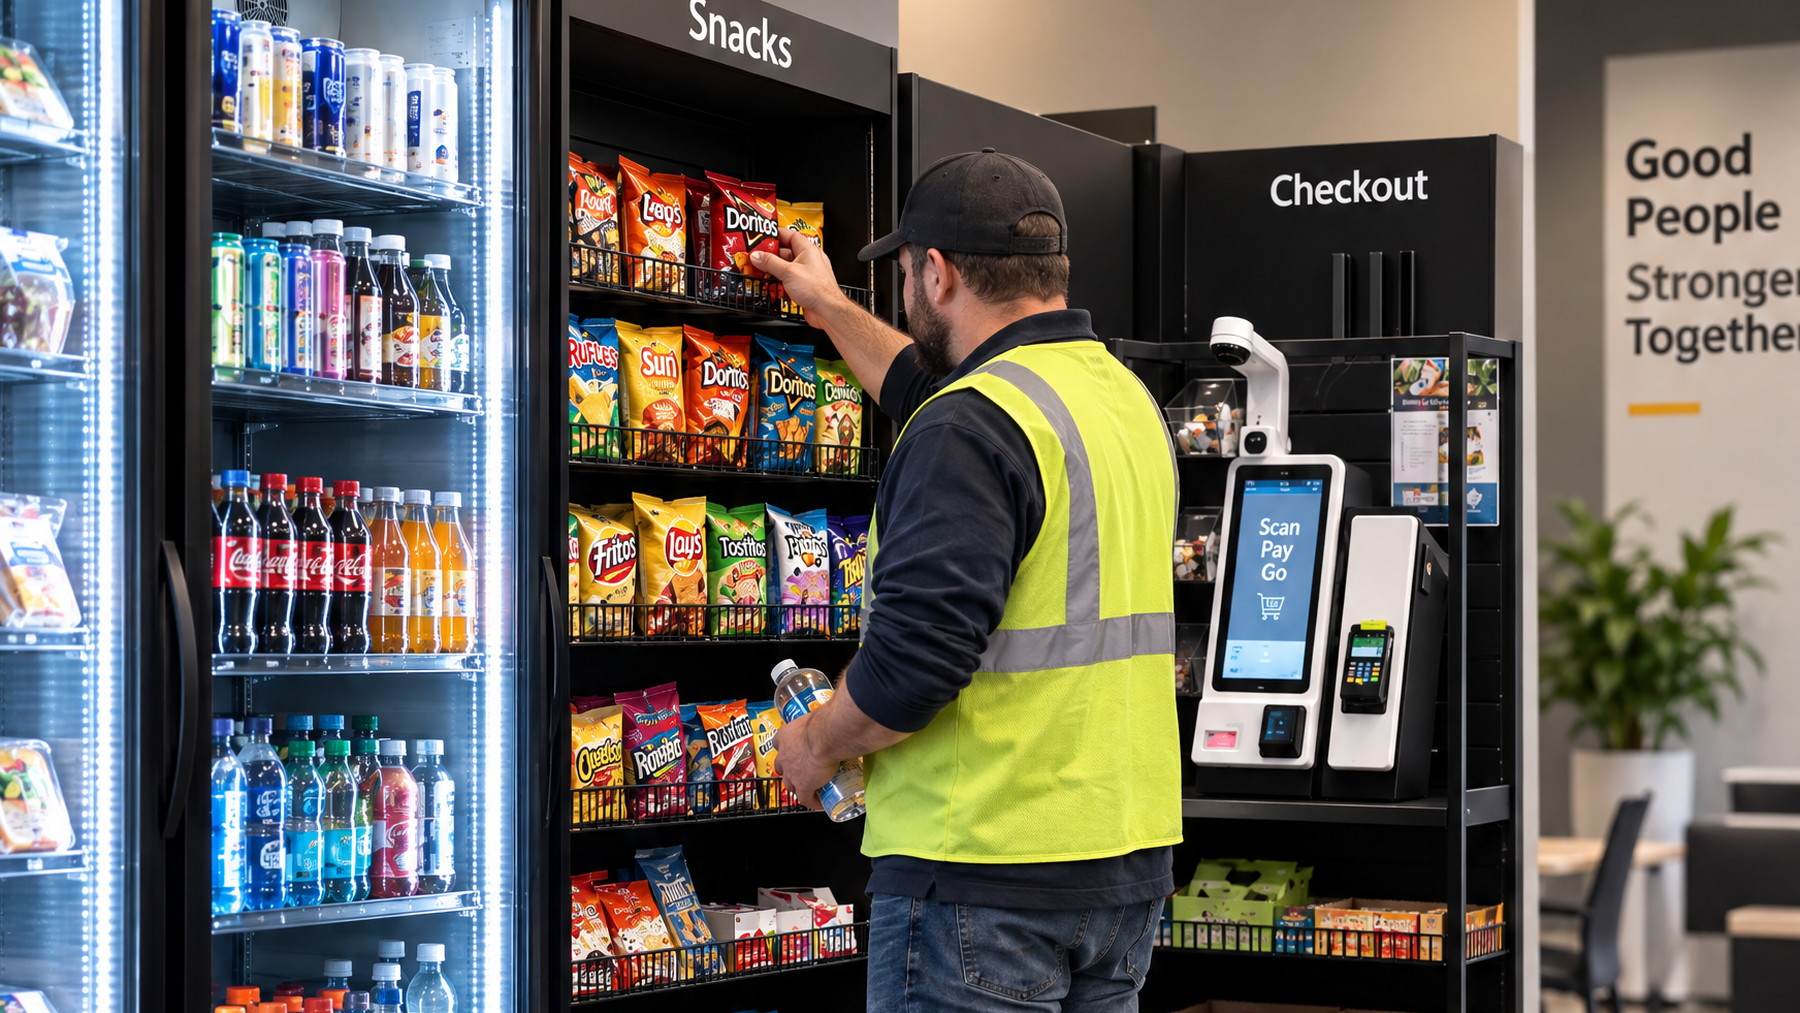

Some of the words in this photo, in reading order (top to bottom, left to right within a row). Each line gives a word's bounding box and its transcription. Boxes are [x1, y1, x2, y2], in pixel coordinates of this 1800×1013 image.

[689, 0, 793, 69] Snacks
[1625, 132, 1752, 181] Good
[1270, 169, 1429, 207] Checkout
[726, 206, 778, 238] Doritos
[1627, 190, 1782, 244] People
[1625, 313, 1800, 365] Togethe
[642, 350, 677, 379] Sun
[770, 370, 816, 400] Doritos
[1258, 517, 1301, 536] Scan
[593, 536, 637, 577] Fritos
[1260, 540, 1294, 562] Pay
[1261, 563, 1288, 582] Go
